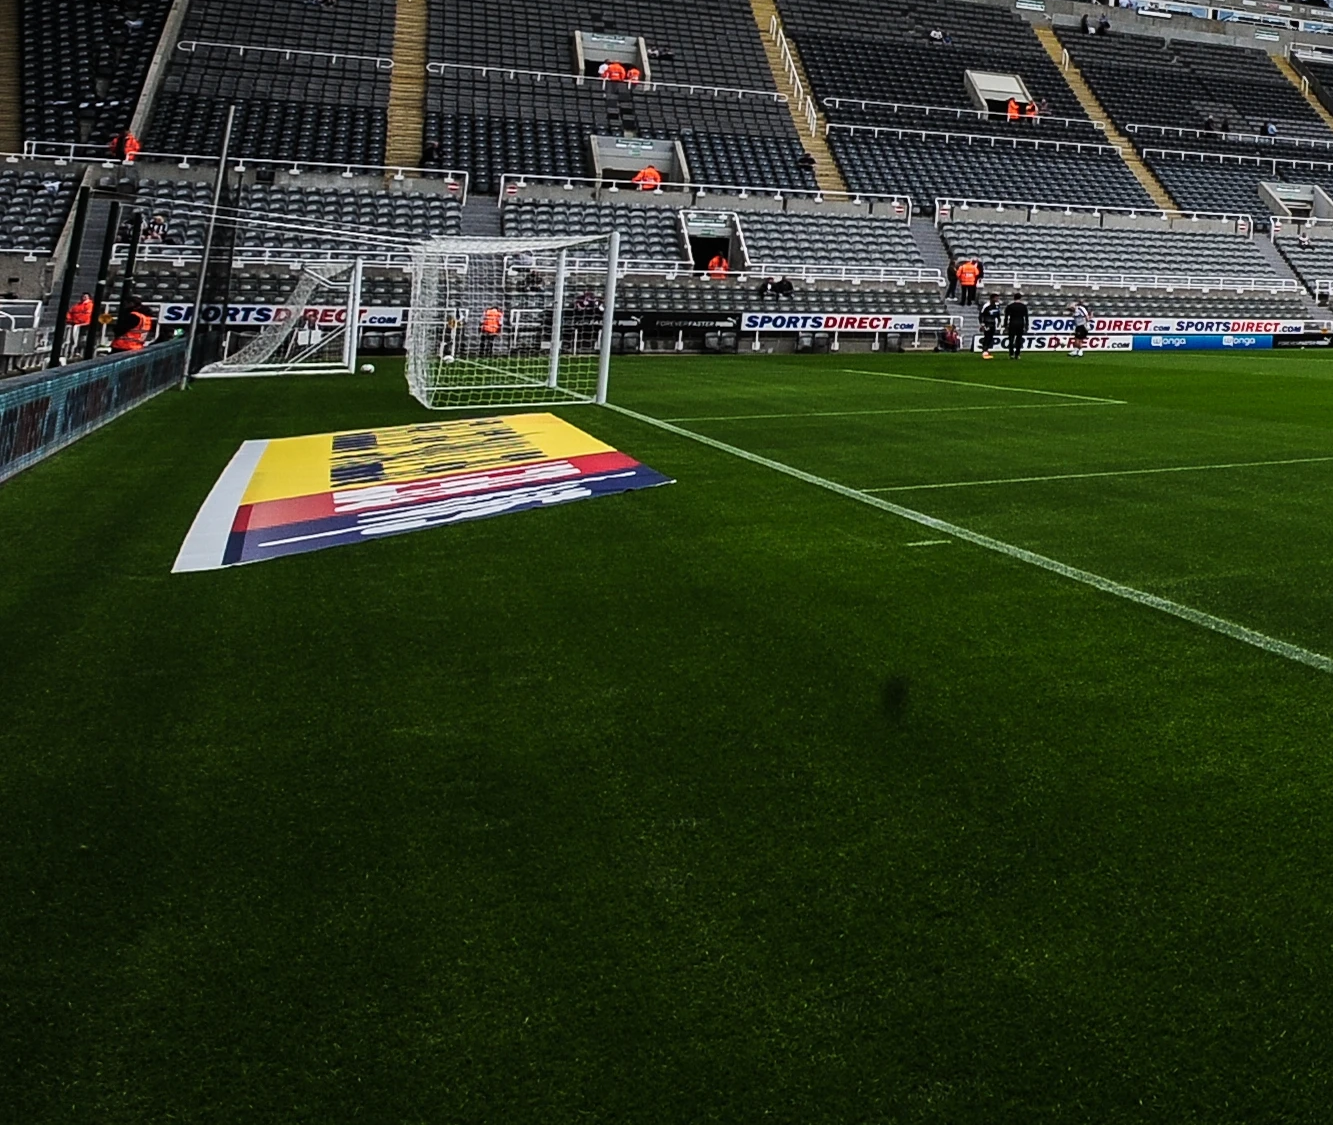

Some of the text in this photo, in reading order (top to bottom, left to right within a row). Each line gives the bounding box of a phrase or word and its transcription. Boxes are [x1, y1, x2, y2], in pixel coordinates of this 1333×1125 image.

[164, 306, 397, 324] SPORTSDRECT.COM
[745, 315, 914, 330] SPORTSDIRECT.COM
[1031, 319, 1170, 332] SPORSDIRECT.COM
[1176, 320, 1302, 333] SPORTSDIRECT.COM
